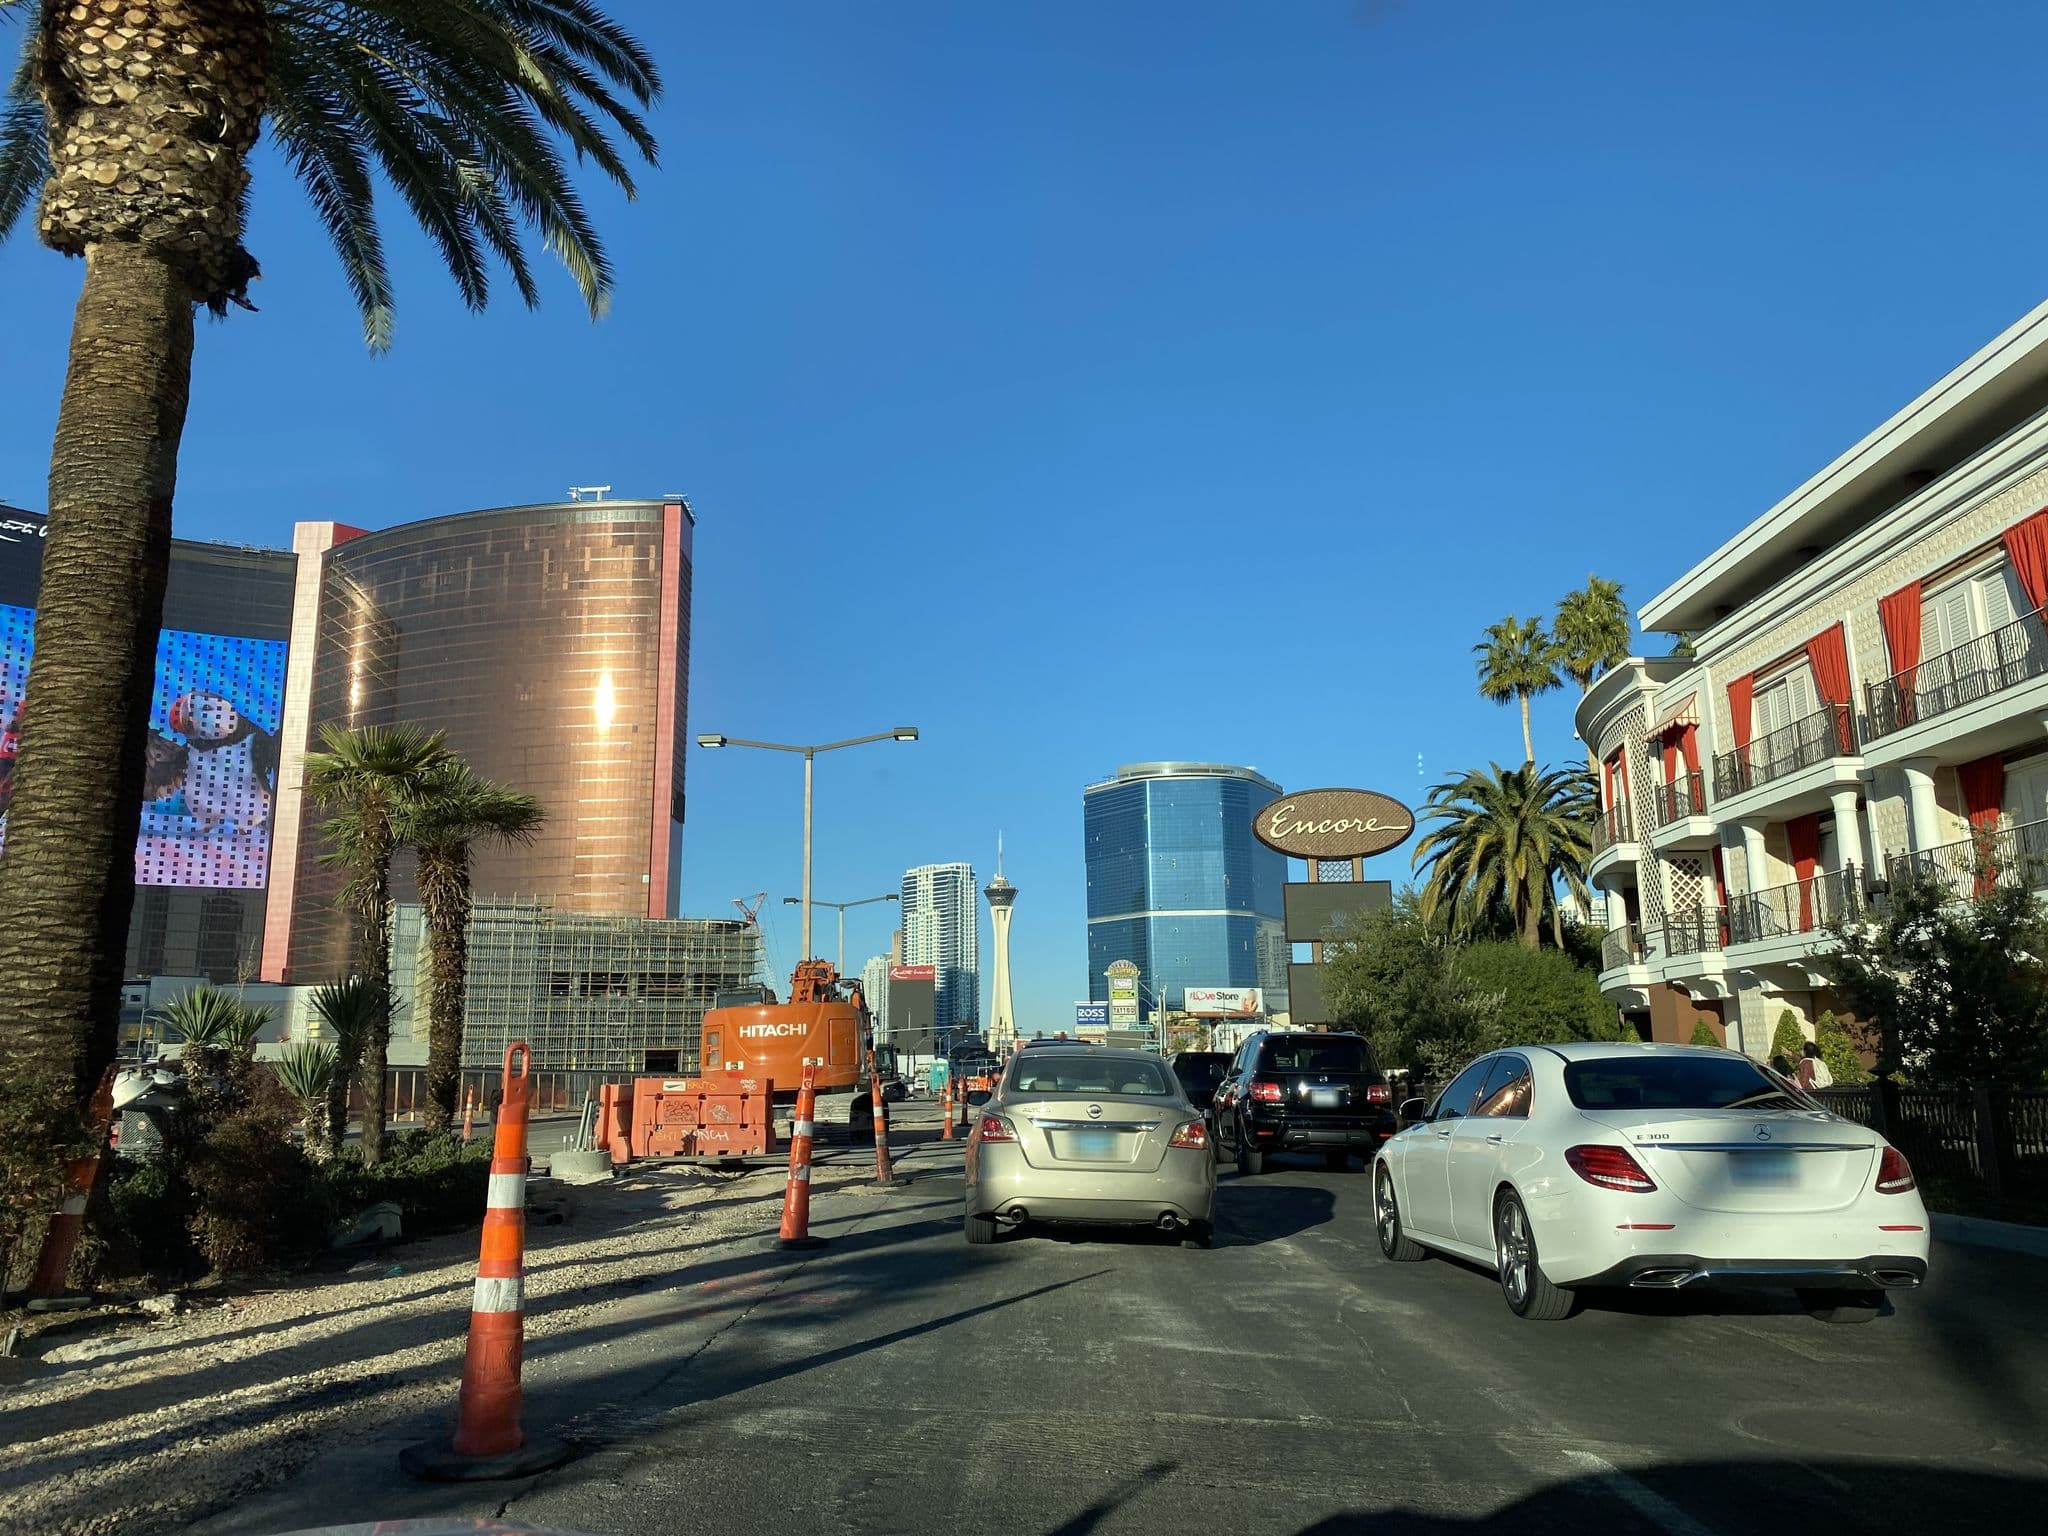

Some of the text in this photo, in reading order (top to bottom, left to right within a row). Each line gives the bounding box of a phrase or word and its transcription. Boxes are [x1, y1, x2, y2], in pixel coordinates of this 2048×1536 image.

[1269, 804, 1408, 838] Encore
[1216, 991, 1239, 1000] Store
[1078, 1008, 1105, 1018] ROSS
[1113, 1007, 1136, 1015] TATTOO
[739, 1023, 807, 1038] HITACHI
